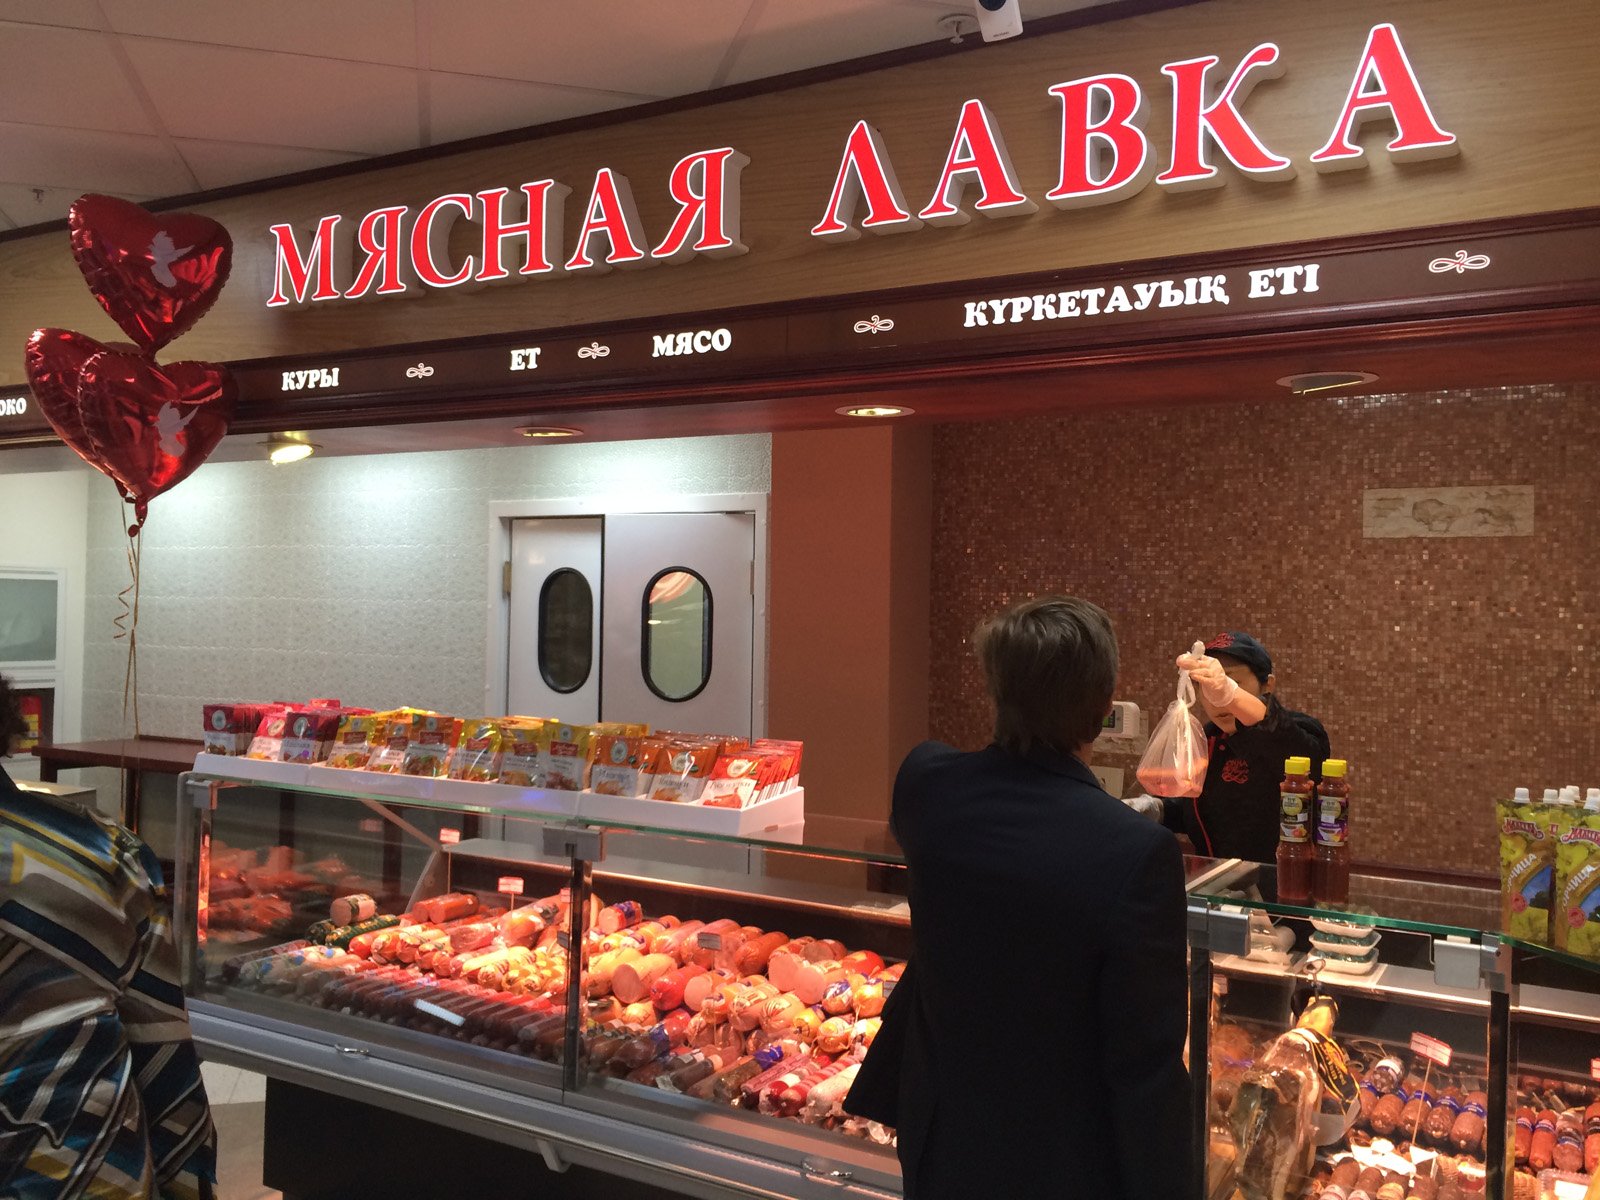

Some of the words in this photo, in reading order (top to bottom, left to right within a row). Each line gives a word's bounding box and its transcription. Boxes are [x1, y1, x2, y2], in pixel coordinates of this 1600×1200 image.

[266, 146, 735, 308] МЯСНАЯ
[811, 23, 1457, 237] ЛАВКА
[963, 274, 1229, 328] КҮРКЕТАУЫҚ
[1248, 264, 1320, 299] ЕТІ
[652, 328, 732, 358] МЯСО
[510, 347, 541, 371] ЕТ
[281, 367, 340, 391] КУРЫ
